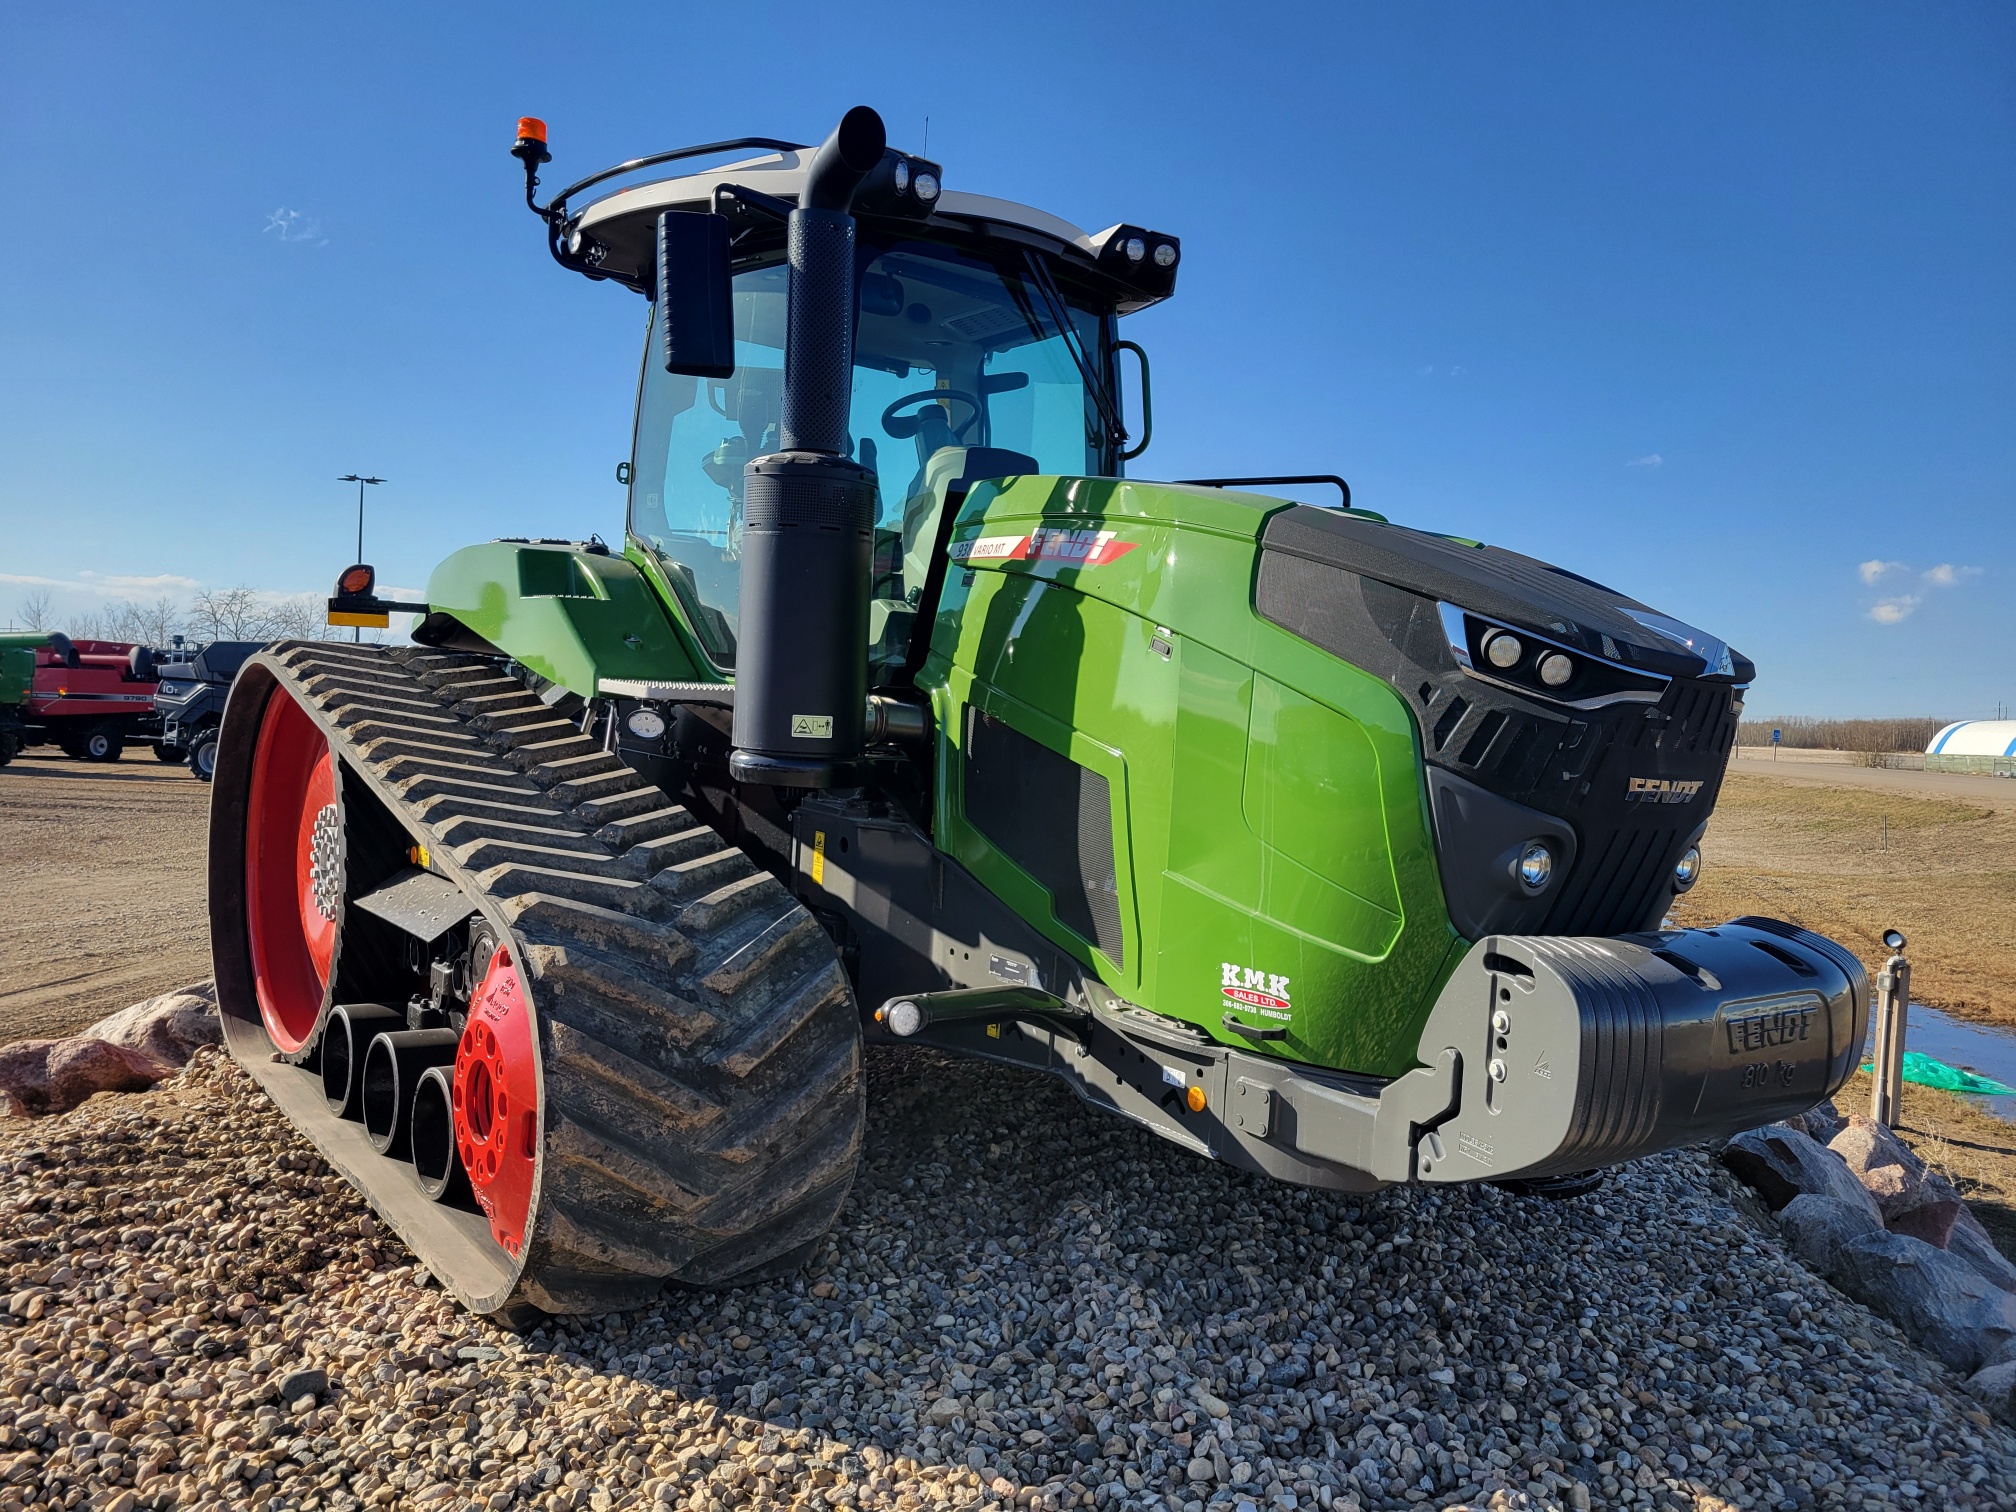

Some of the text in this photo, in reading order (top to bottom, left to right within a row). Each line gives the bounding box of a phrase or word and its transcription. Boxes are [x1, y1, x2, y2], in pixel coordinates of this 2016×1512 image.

[974, 543, 994, 556] VARIO
[993, 543, 1006, 555] MT
[1027, 528, 1117, 560] FENDT
[1625, 777, 1704, 804] FENDT
[1233, 990, 1278, 1007] SALES LTD.
[1260, 1008, 1292, 1021] HUMBOLDT
[1726, 1007, 1818, 1054] FENDT
